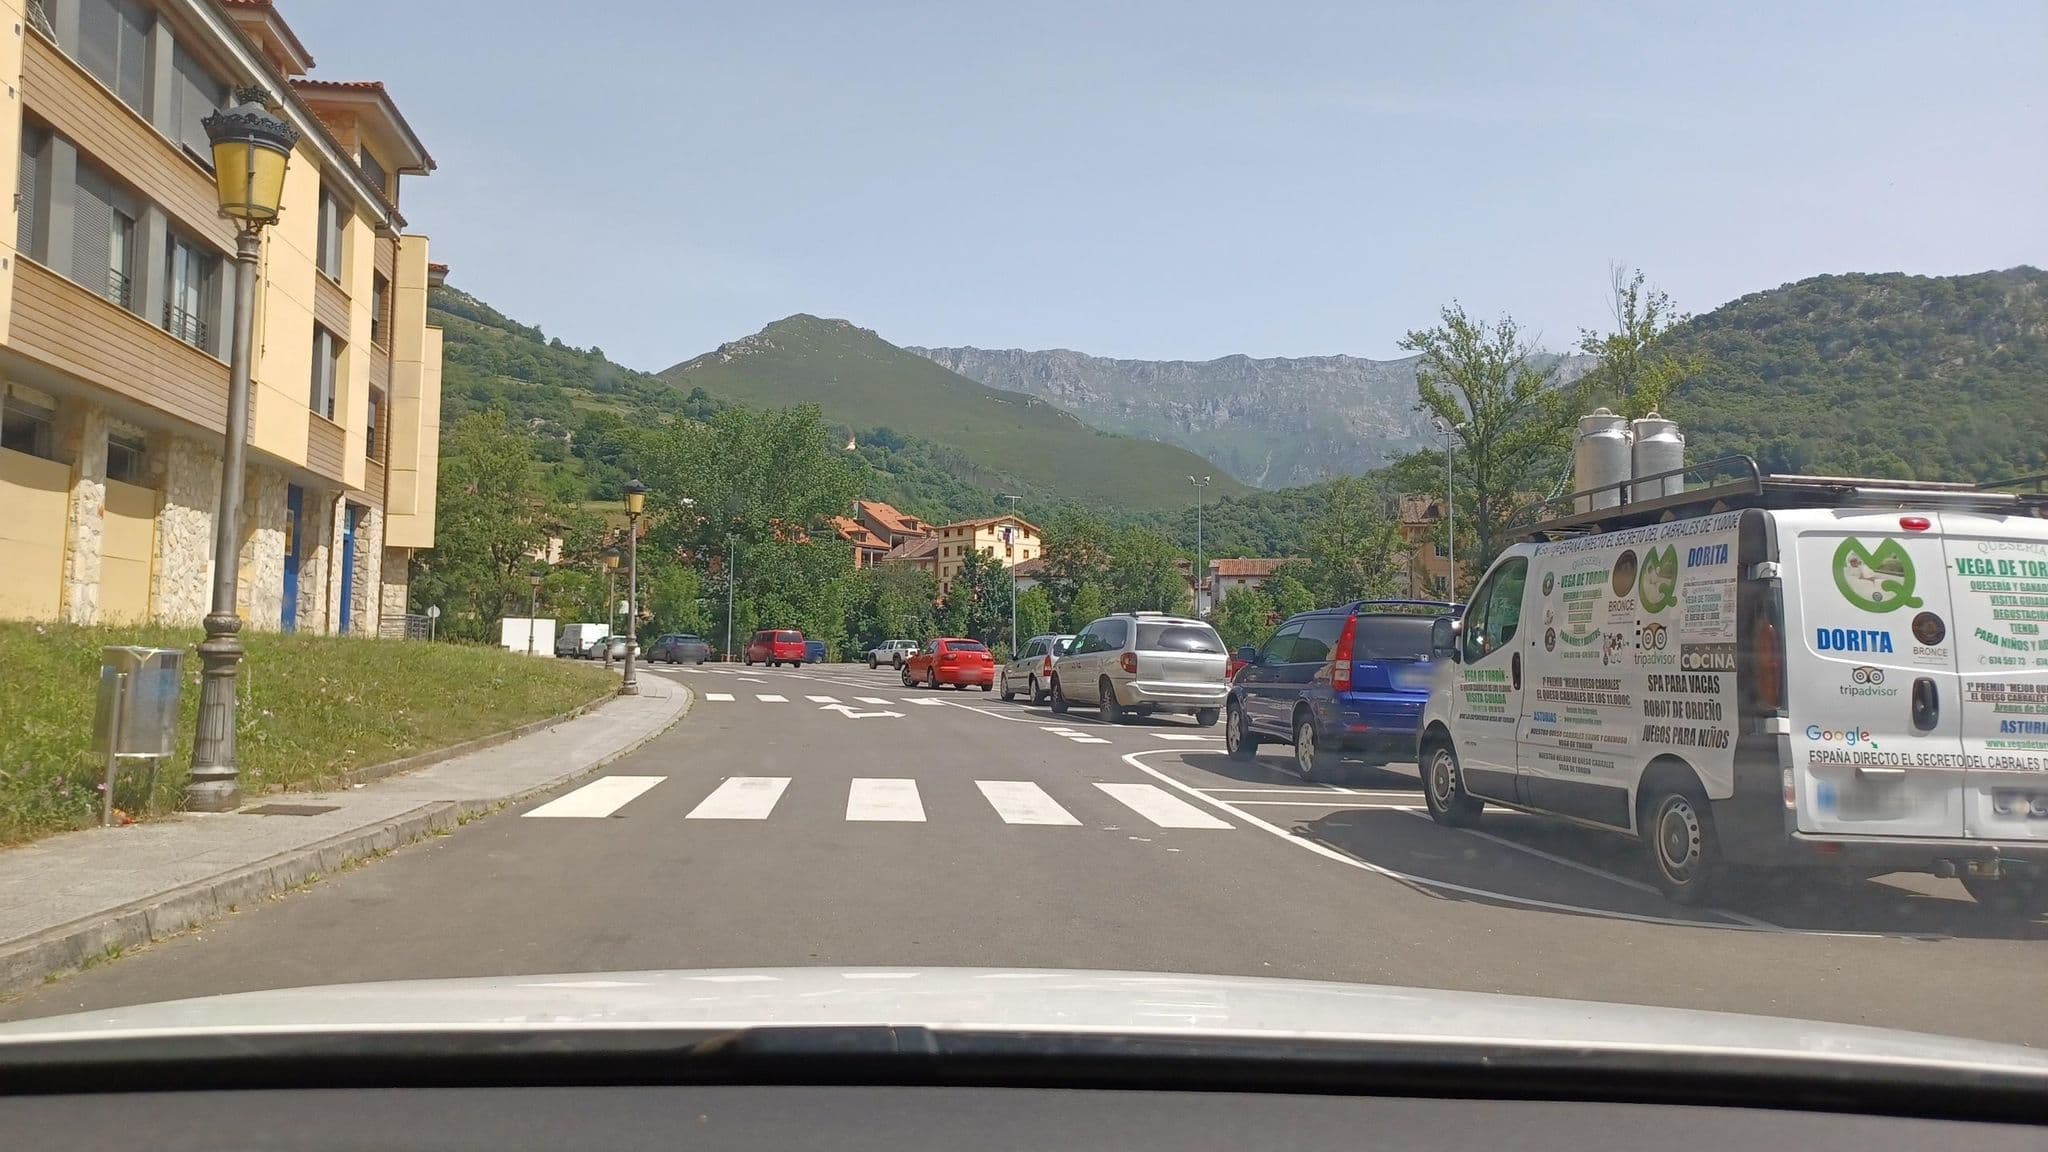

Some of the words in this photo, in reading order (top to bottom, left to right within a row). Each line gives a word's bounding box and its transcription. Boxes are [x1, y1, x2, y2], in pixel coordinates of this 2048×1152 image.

[1615, 529, 1645, 545] SECRETO
[1645, 528, 1658, 542] DEL
[1660, 520, 1700, 540] CABRALES
[1699, 518, 1712, 533] DE
[1687, 544, 1728, 568] DORITA
[1955, 558, 1995, 575] VEGA
[1998, 559, 2017, 576] DE
[1561, 573, 1576, 588] VEGA
[1576, 572, 1585, 587] DE
[2013, 583, 2018, 592] Y
[1608, 599, 1635, 612] BRONCE
[1990, 595, 2018, 605] VISITA
[2009, 623, 2039, 633] TIENDA
[1817, 628, 1893, 653] DORITA
[1974, 627, 1999, 646] PARA
[2001, 637, 2029, 651] NIÑOS
[2030, 641, 2036, 651] Y
[1634, 652, 1676, 668] tripadvisor
[1913, 647, 1948, 657] BRONCE
[1681, 652, 1735, 669] COCINA
[1580, 678, 1594, 690] QUESO
[1648, 674, 1664, 692] SPA
[1665, 674, 1688, 693] PARA
[1688, 675, 1720, 694] VACAS
[1840, 685, 1898, 697] tripadvisor
[1976, 682, 2005, 692] PREMIO
[1536, 689, 1542, 699] EL
[1543, 689, 1559, 701] QUESO
[1559, 690, 1586, 702] CABRALES
[1587, 692, 1594, 703] DE
[1595, 693, 1606, 704] LOS
[1980, 692, 2006, 701] QUESO
[2007, 693, 2046, 702] CABRALES
[1534, 711, 1557, 723] ASTURIAS
[1644, 699, 1671, 718] ROBOT
[1672, 700, 1683, 719] DE
[1685, 698, 1722, 721] ORDEÑO
[1806, 725, 1870, 745] Google
[2000, 720, 2048, 735] ASTURI
[1642, 724, 1671, 744] JUEGOS
[1672, 726, 1696, 746] PARA
[1697, 726, 1729, 749] NIÑOS
[1809, 748, 1850, 763] ESPAÑA
[1854, 751, 1899, 765] DIRECTO
[1902, 753, 1915, 766] EL
[1916, 753, 1965, 767] SECRETO
[1967, 755, 1986, 768] DEL
[1988, 756, 2040, 770] CABRALES
